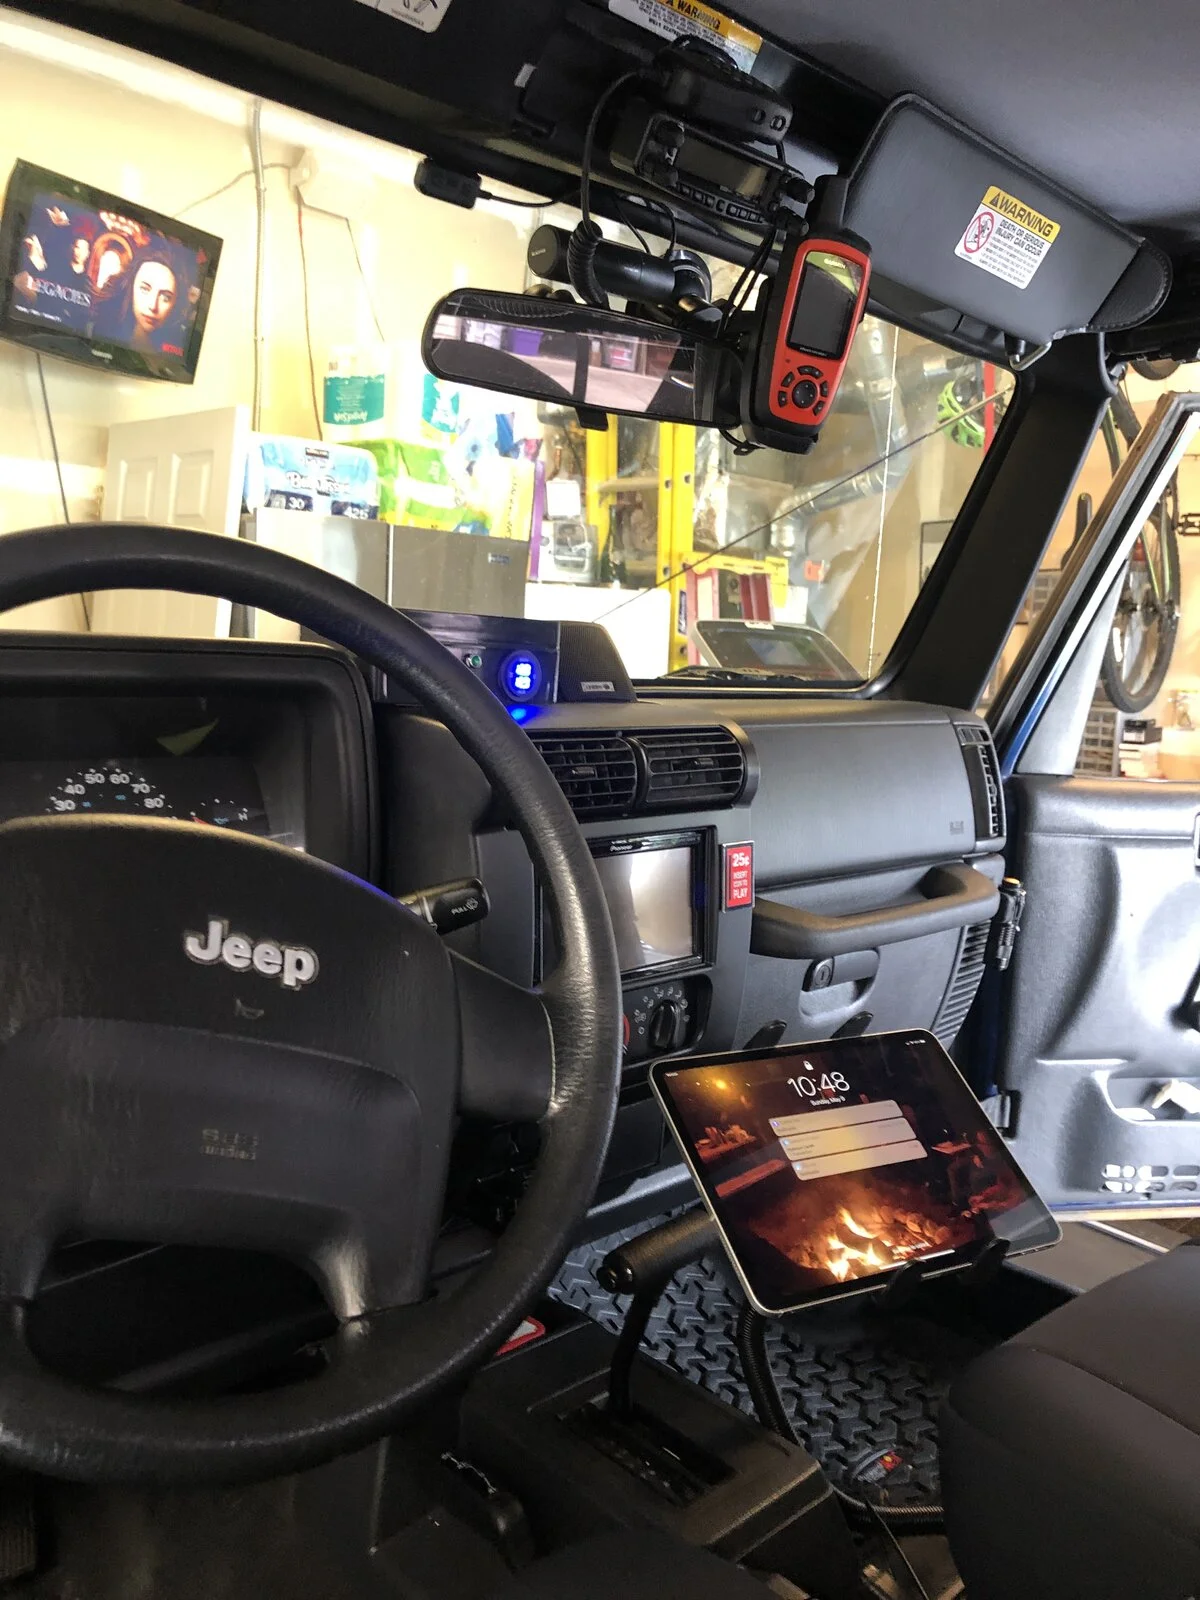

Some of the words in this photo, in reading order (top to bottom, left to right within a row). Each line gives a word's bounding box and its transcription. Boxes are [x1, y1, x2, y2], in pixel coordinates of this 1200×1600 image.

[677, 0, 720, 30] WARNING
[999, 197, 1054, 238] WARNING
[1000, 219, 1017, 233] DEATH
[1016, 228, 1025, 238] OR
[1023, 233, 1045, 249] SERIOUS
[995, 227, 1015, 242] INJURY
[1013, 237, 1025, 248] CAN
[1024, 243, 1042, 256] OCCUR
[84, 773, 105, 784] 50
[109, 773, 130, 785] 60
[64, 784, 86, 795] 40
[130, 783, 151, 794] 70
[54, 800, 76, 812] 30
[143, 798, 164, 808] 80
[733, 888, 748, 900] PLAY
[184, 916, 319, 989] Jeep
[787, 1071, 850, 1098] 10:48
